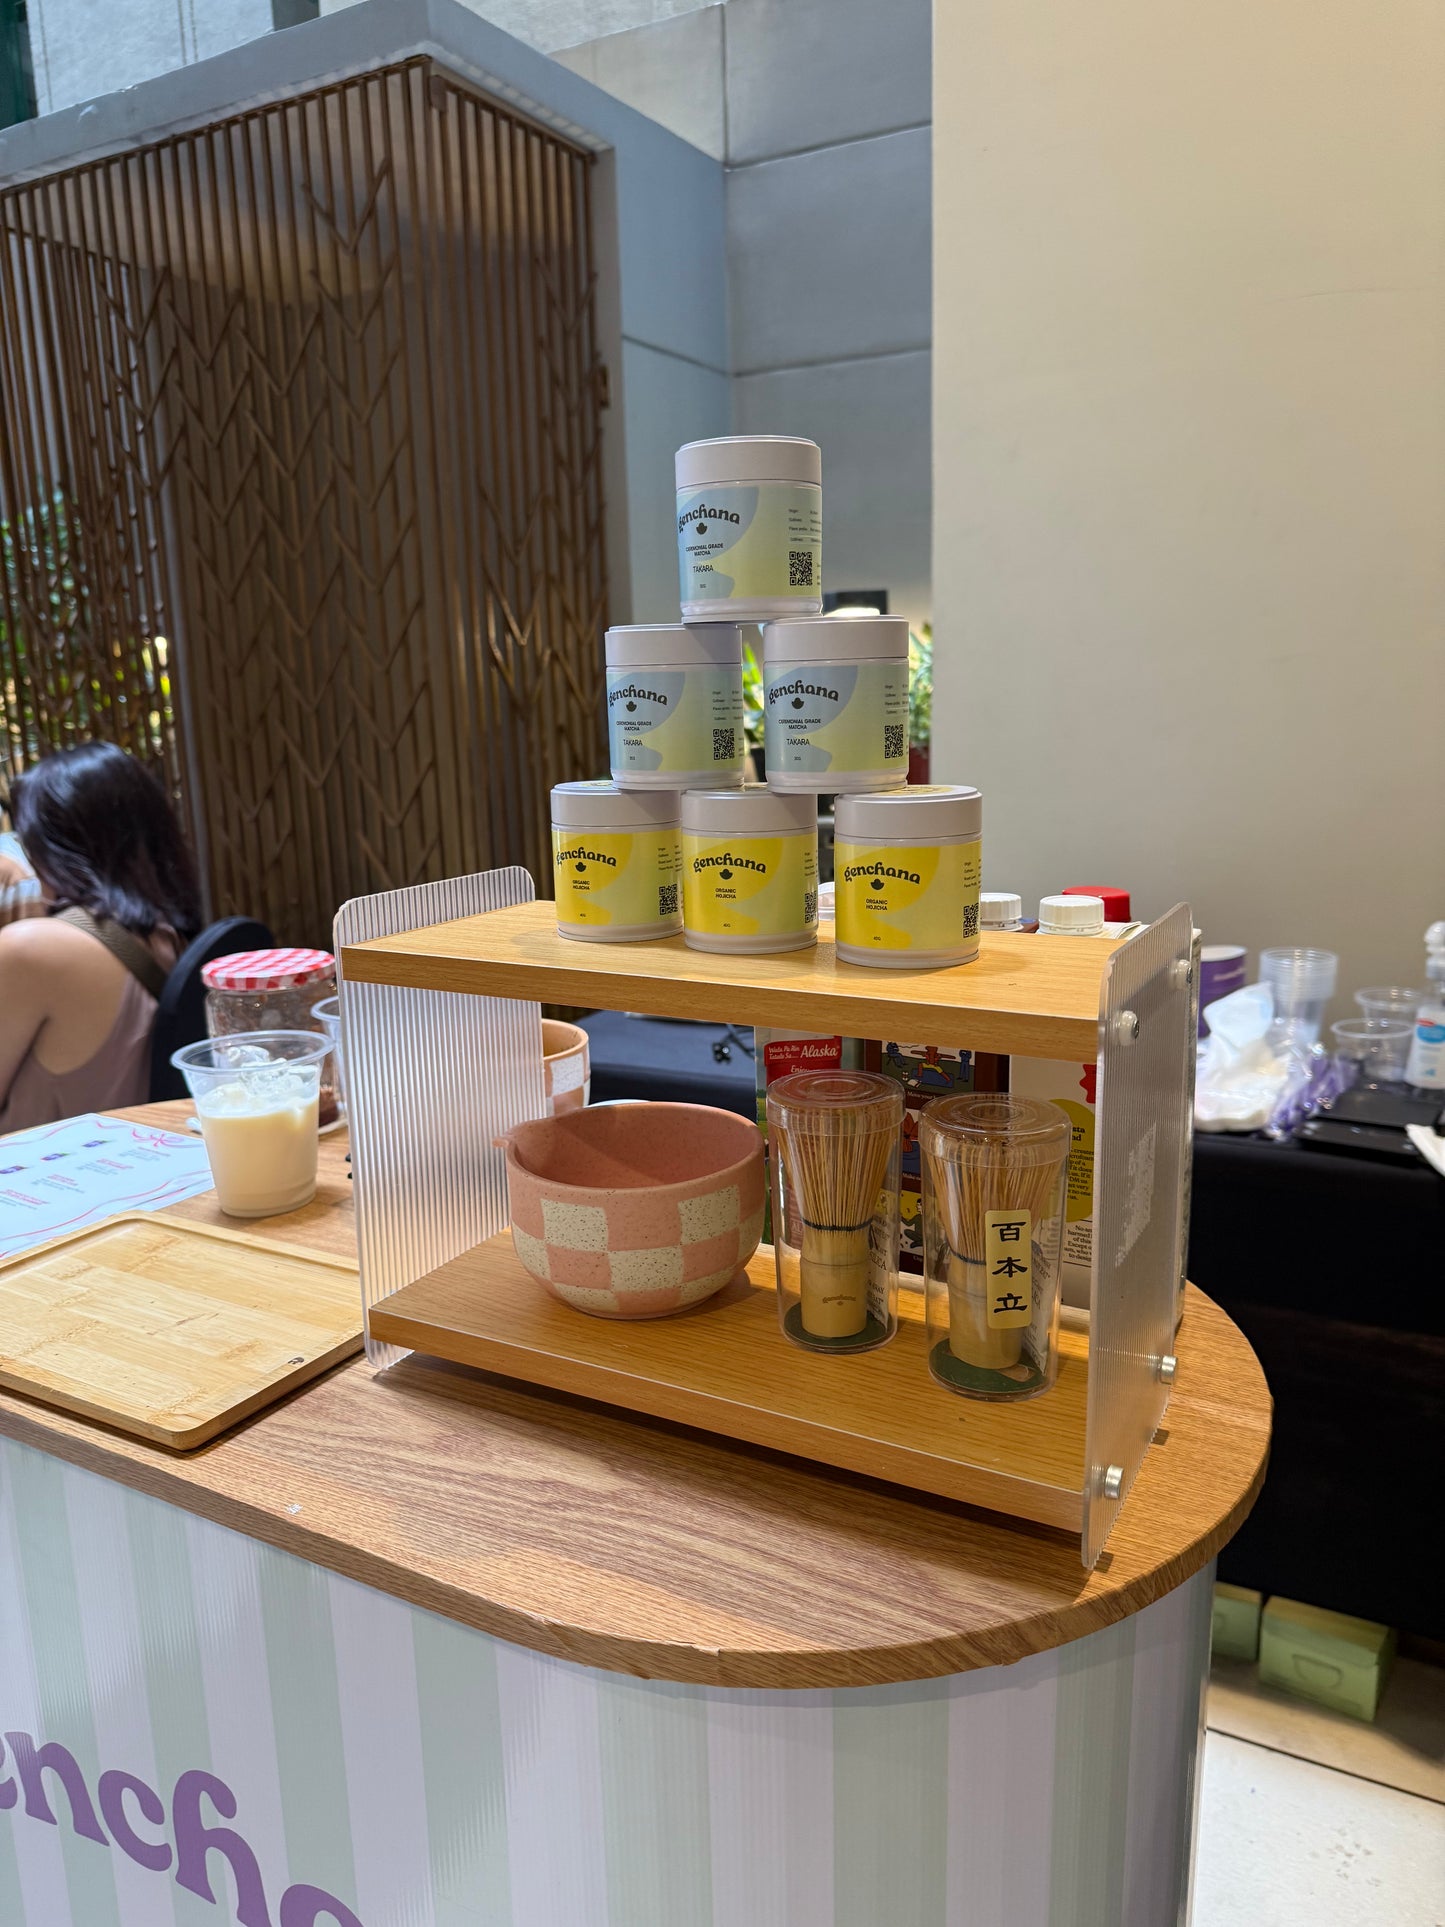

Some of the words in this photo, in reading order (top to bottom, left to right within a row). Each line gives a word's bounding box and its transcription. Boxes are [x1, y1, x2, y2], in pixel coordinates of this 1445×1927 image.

[678, 503, 741, 534] genchana
[693, 564, 714, 573] TAKARA
[608, 684, 668, 707] genchana
[769, 679, 839, 705] genchana
[786, 738, 810, 746] TAKARA
[556, 846, 617, 867] genchana
[693, 852, 766, 874] genchana
[844, 861, 921, 885] genchana
[800, 1043, 838, 1059] Alaska
[991, 1221, 1028, 1314] 百本立
